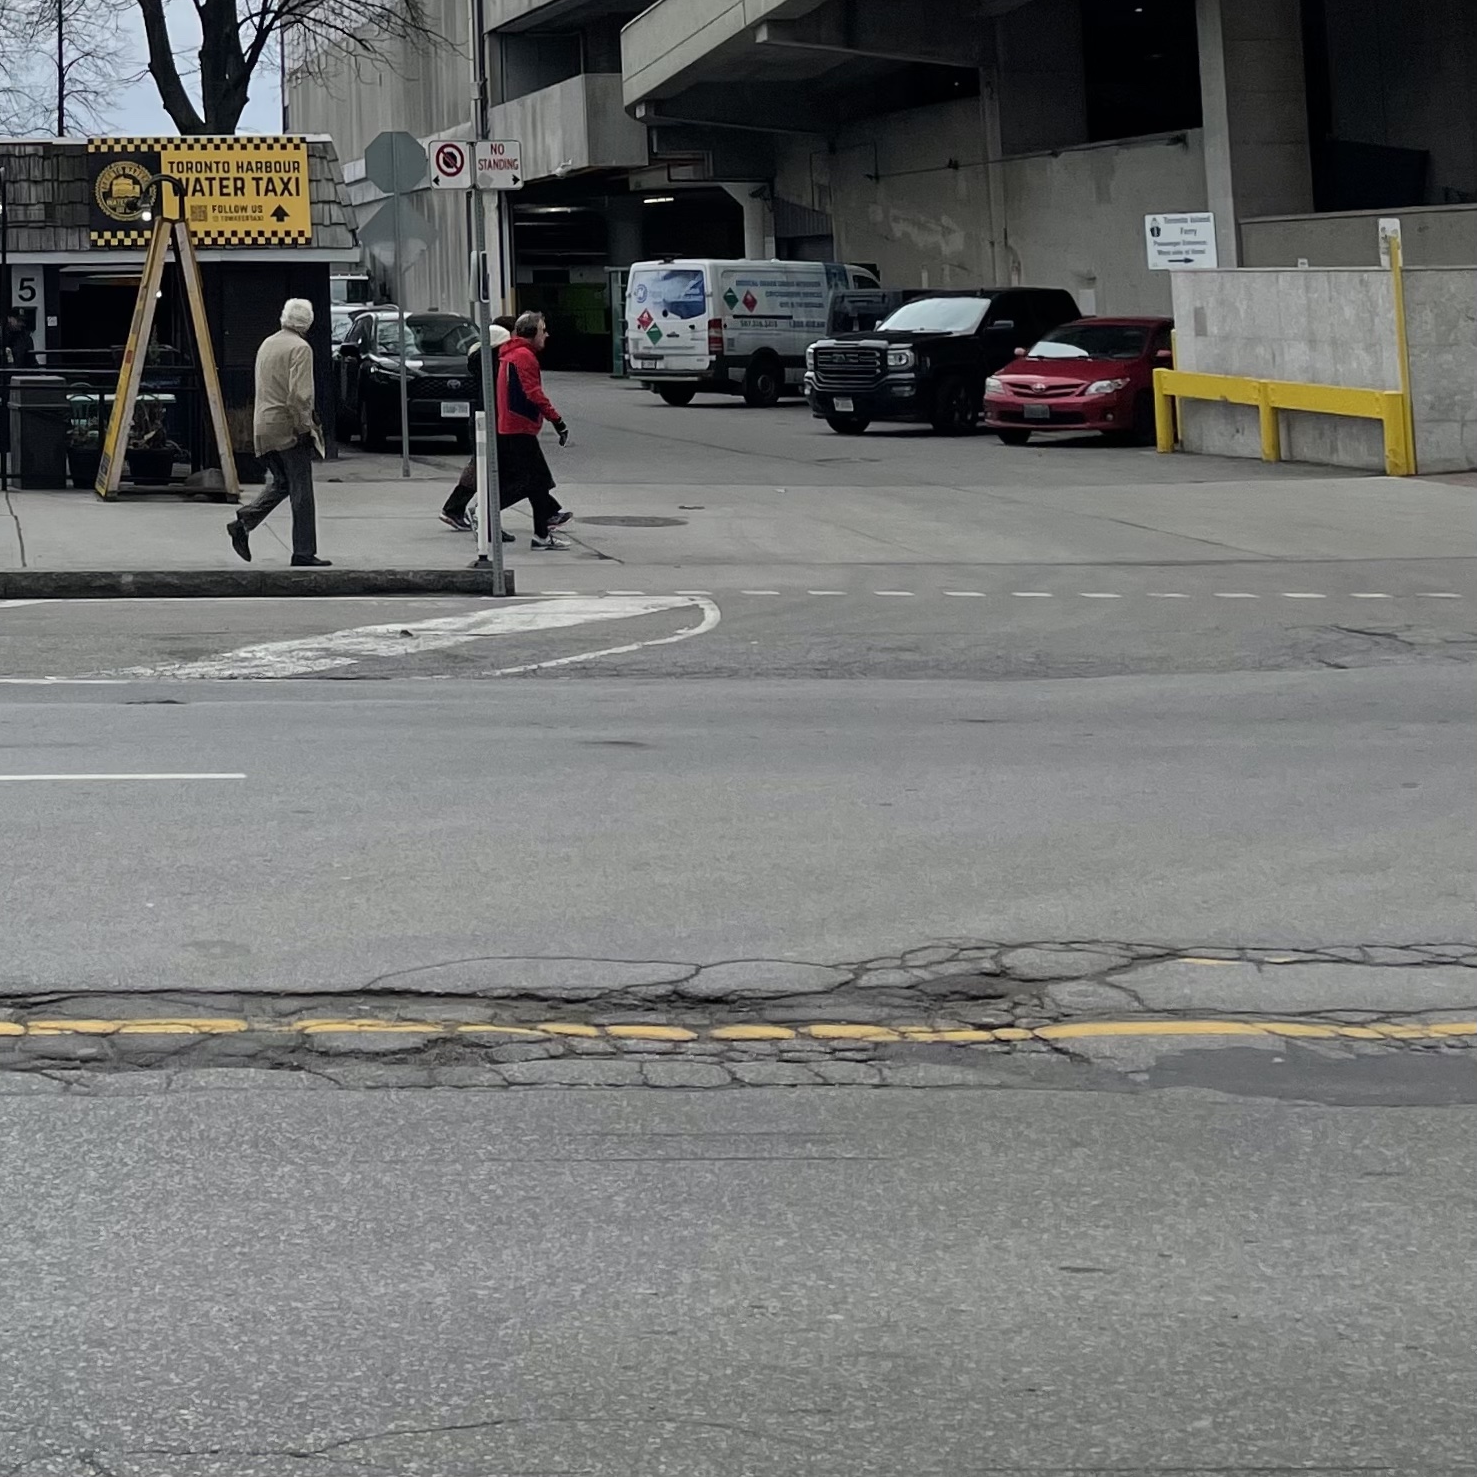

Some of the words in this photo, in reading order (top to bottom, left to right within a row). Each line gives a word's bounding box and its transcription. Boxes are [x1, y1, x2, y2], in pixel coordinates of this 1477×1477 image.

[490, 143, 505, 155] NO
[167, 160, 230, 174] TORONTO
[236, 160, 300, 174] HARBOUR
[478, 158, 519, 171] STANDING
[251, 176, 301, 197] TAXI
[211, 204, 248, 214] FOLLOW
[251, 204, 263, 214] US
[18, 277, 36, 302] 5
